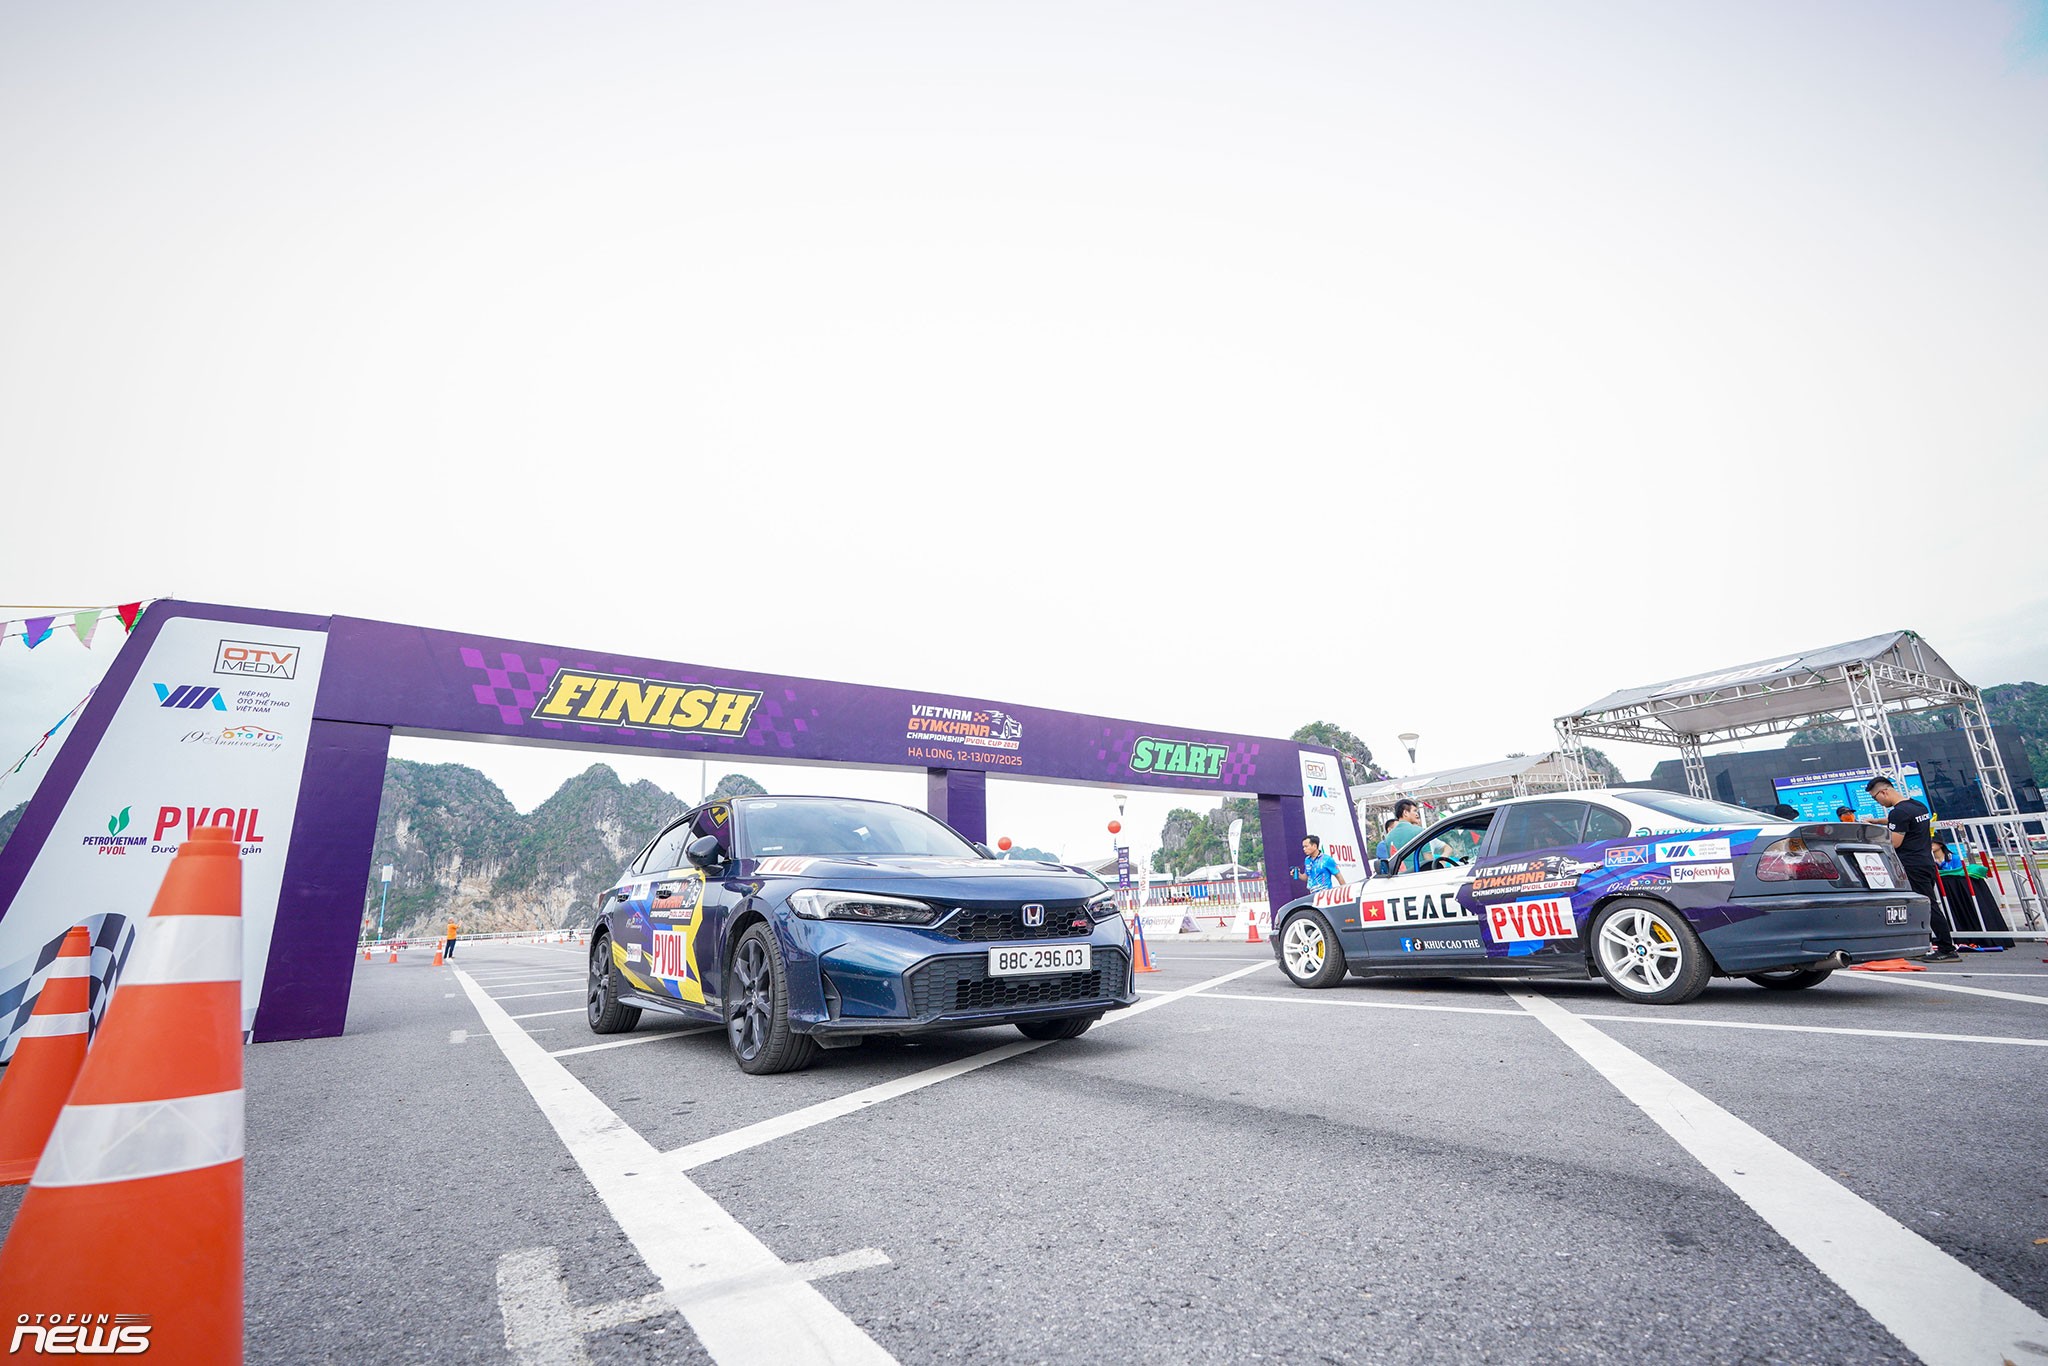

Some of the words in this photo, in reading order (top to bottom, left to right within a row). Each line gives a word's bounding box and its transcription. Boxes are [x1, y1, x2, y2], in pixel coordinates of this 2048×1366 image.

[224, 647, 293, 664] OTV
[221, 660, 291, 678] MEDIA
[542, 674, 756, 732] FINISH
[911, 704, 972, 722] VIETNAM
[908, 718, 990, 737] GYMKHANA
[906, 732, 965, 743] CHAMPIONSHIP
[987, 739, 1003, 747] CUP
[1003, 741, 1018, 749] 2025
[908, 747, 923, 759] HẠ
[925, 747, 955, 761] LONG,
[957, 751, 1023, 766] 12-13/07/2025
[1133, 740, 1226, 775] START
[83, 836, 147, 846] PETROVIETNAM
[98, 846, 126, 855] PVOIL
[1329, 845, 1356, 862] PVOIL
[1608, 847, 1645, 857] OTV
[1608, 855, 1648, 864] MEDIA
[1475, 862, 1528, 877] VIETNAM
[1674, 866, 1730, 880] Ekokemika
[1471, 885, 1521, 897] CHAMPIONSHIP
[1543, 881, 1559, 889] CUP
[1472, 871, 1546, 890] GYMKHANA
[1316, 885, 1354, 906] PVOIL
[1387, 893, 1477, 922] TEAC
[1491, 902, 1573, 940] PVOIL
[1424, 940, 1446, 949] KHUC
[1446, 940, 1462, 949] CAO
[1462, 939, 1480, 949] THE
[653, 933, 685, 977] PVOIL
